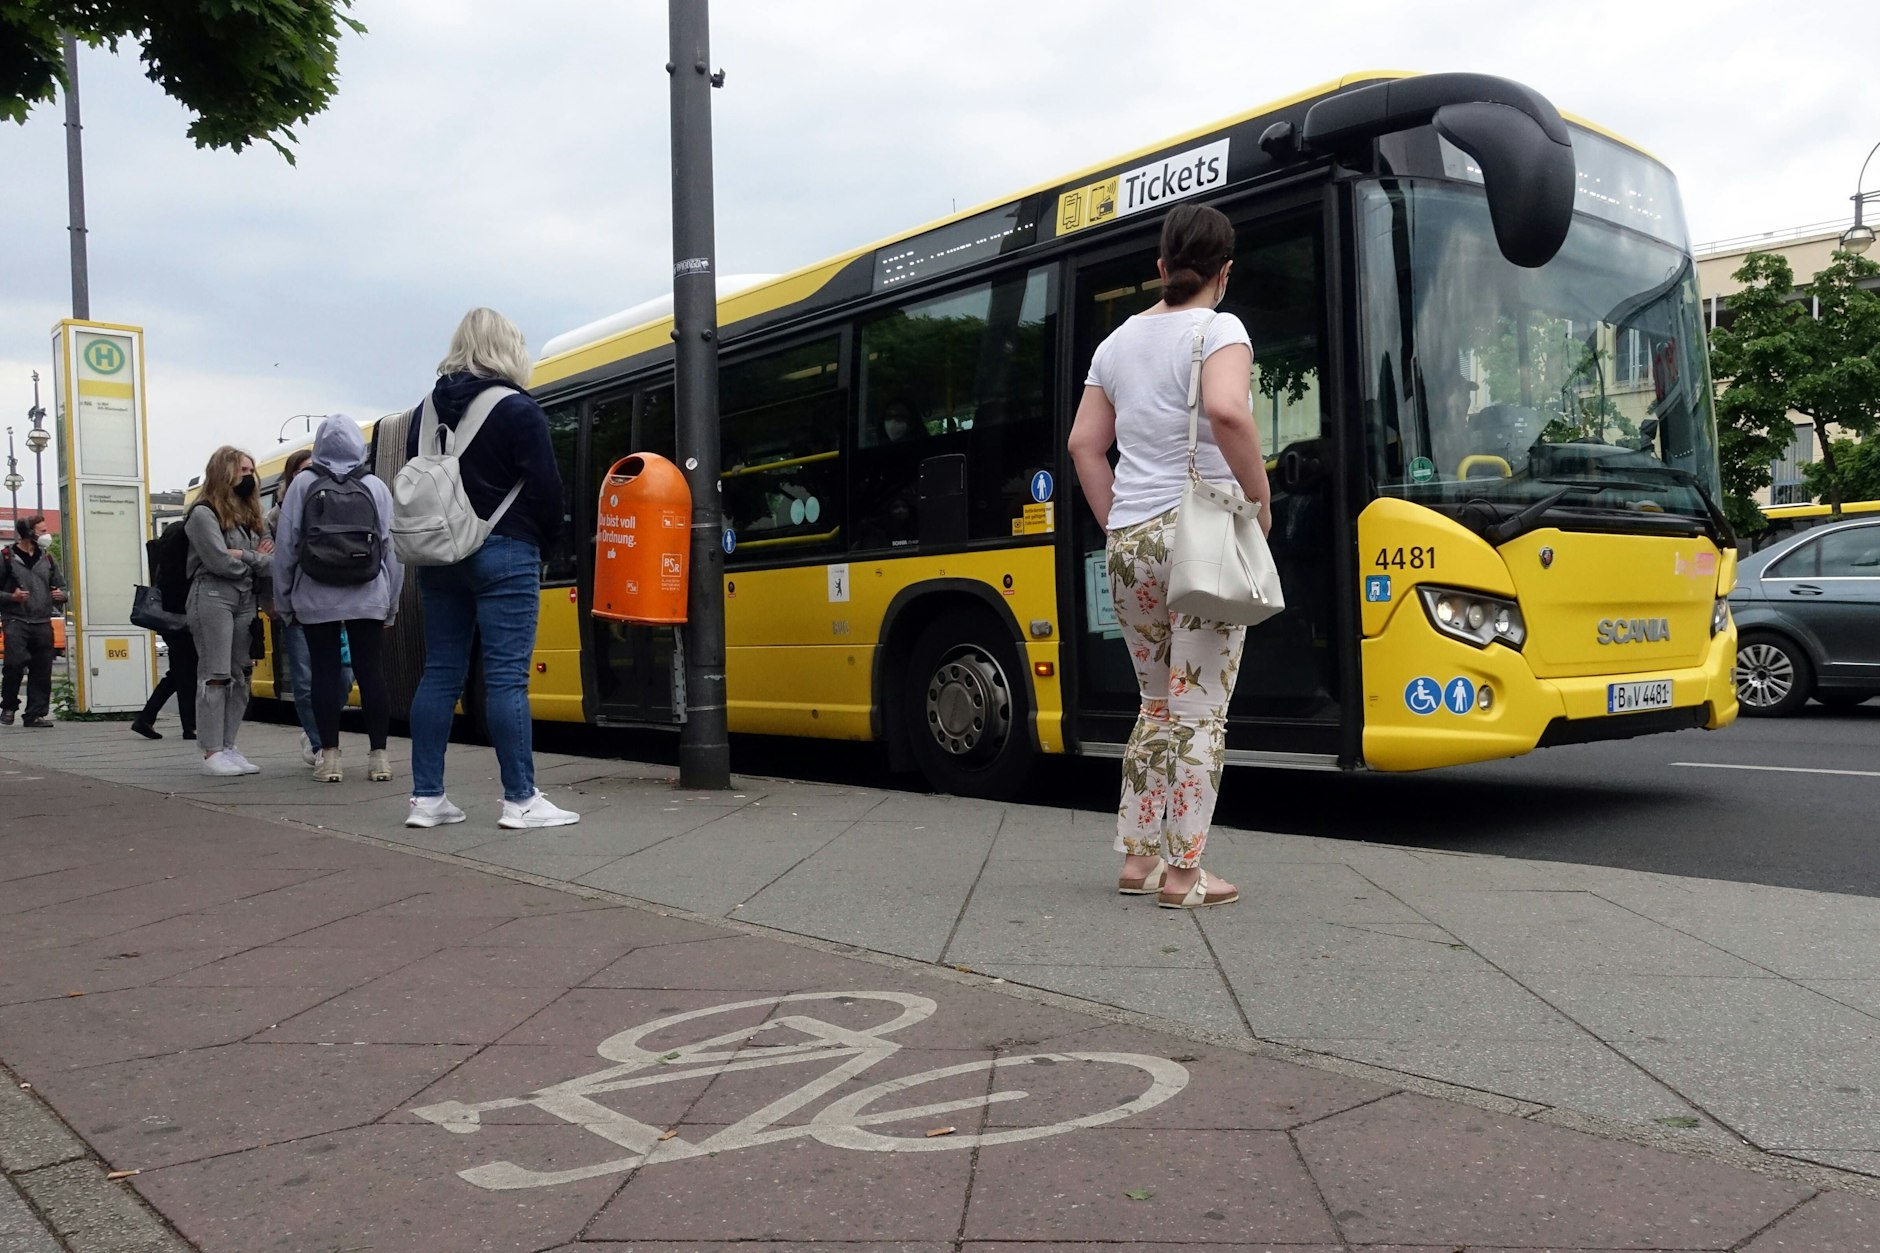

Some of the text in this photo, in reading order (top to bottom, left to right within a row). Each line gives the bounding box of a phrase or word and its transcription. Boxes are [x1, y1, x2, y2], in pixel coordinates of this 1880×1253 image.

[1125, 156, 1220, 209] Tickets
[95, 346, 114, 367] H
[606, 514, 619, 528] bist
[620, 515, 636, 529] voll
[602, 529, 637, 548] Ordnung.
[663, 557, 680, 573] BSR
[1375, 546, 1435, 570] 4481
[1597, 618, 1671, 645] SCANIA
[108, 649, 127, 658] BVG
[1618, 687, 1626, 708] B
